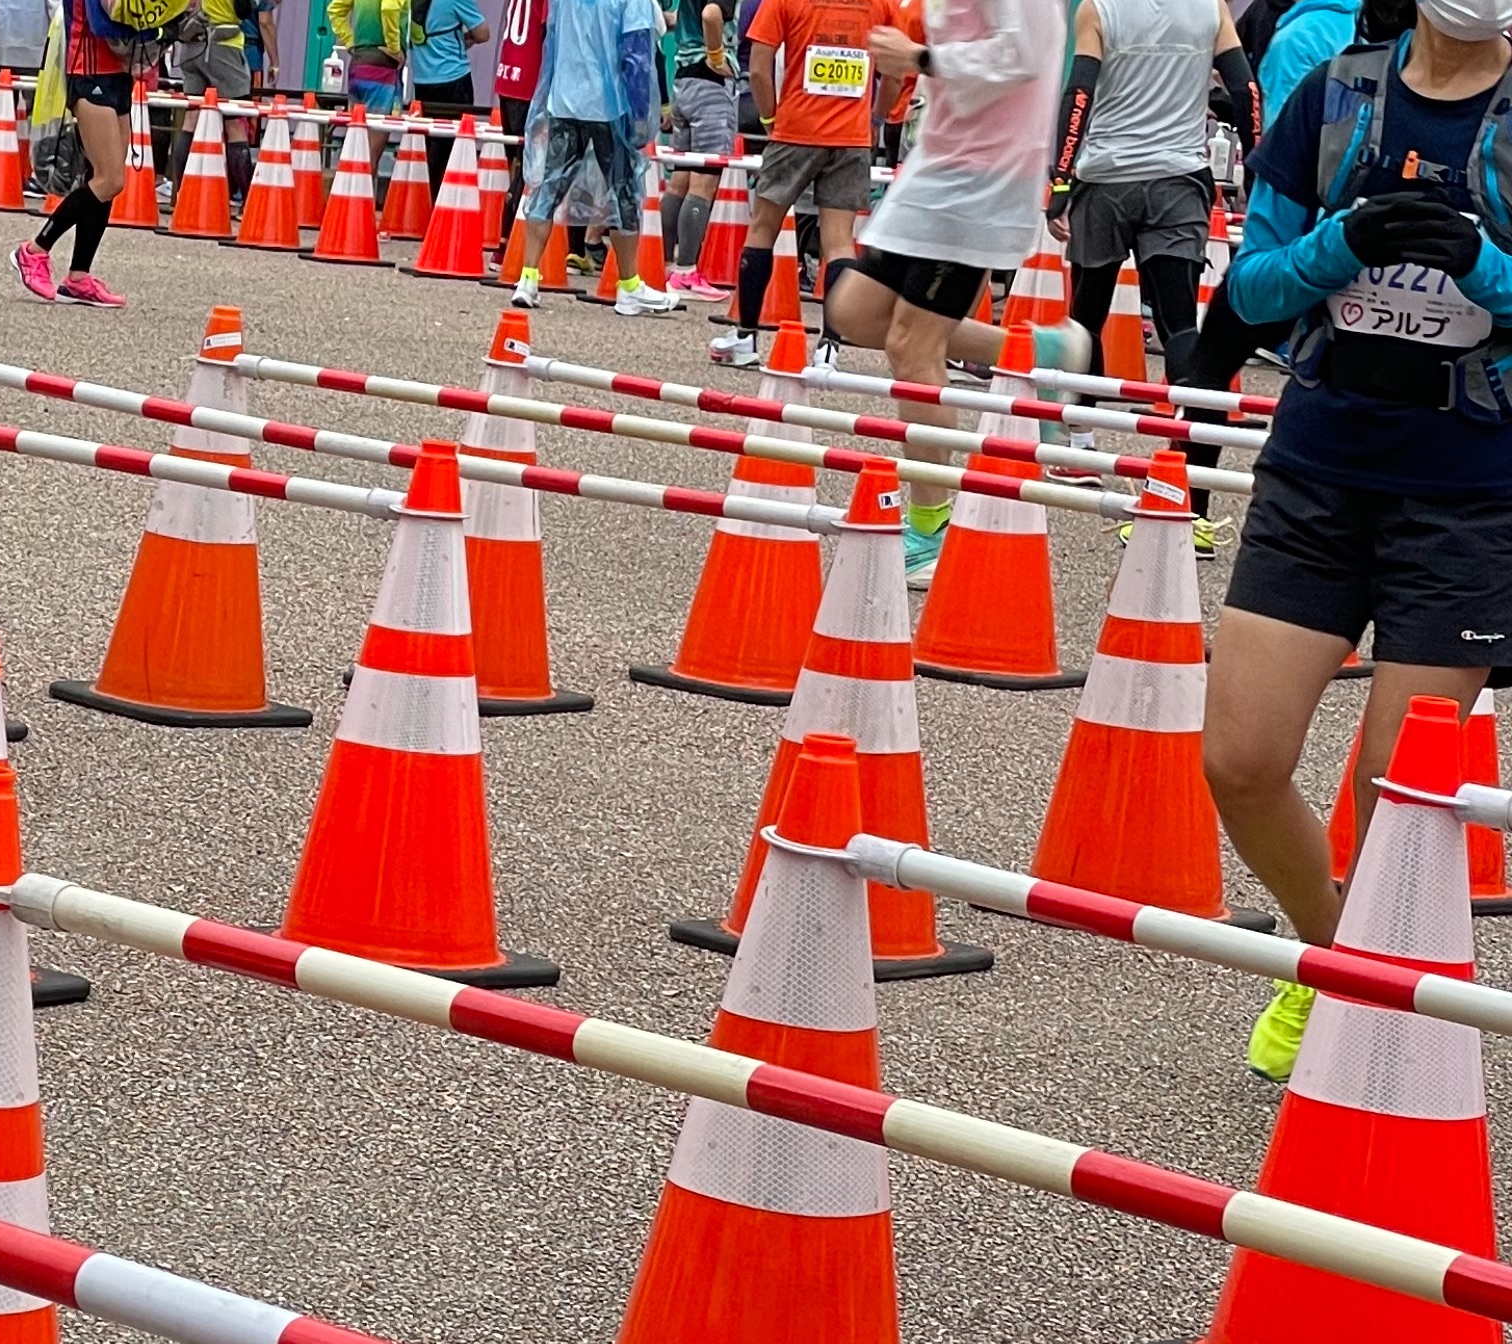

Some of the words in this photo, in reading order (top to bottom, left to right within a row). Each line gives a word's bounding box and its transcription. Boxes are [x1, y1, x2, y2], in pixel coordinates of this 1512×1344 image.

[1069, 108, 1083, 135] new
[1370, 307, 1451, 338] アルプ
